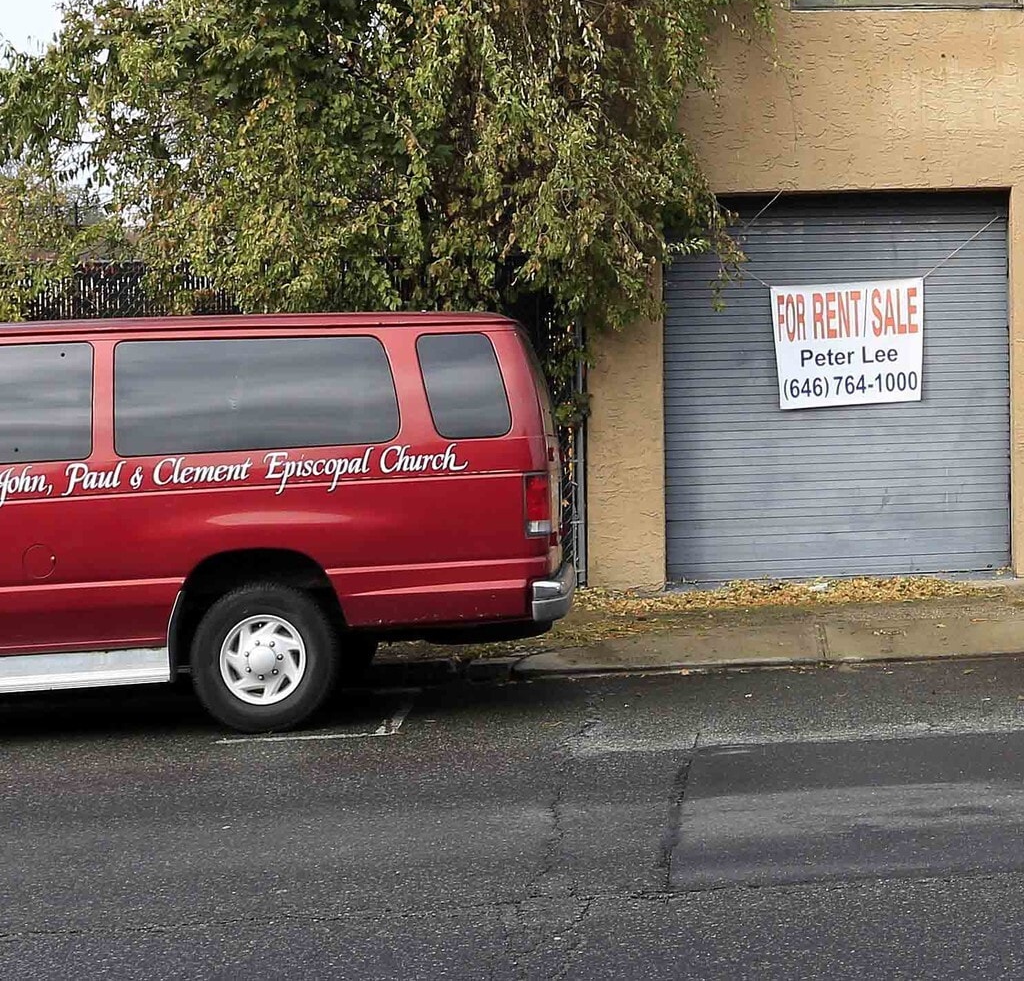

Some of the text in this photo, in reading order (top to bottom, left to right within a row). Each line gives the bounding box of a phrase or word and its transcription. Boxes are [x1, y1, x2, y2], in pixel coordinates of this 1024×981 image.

[776, 293, 806, 342] FOR
[800, 346, 898, 367] Peter Lee
[61, 461, 127, 496] Paul
[129, 467, 144, 489] &
[152, 456, 253, 486] Clement
[263, 447, 374, 495] Episcopal
[379, 443, 468, 474] Church
